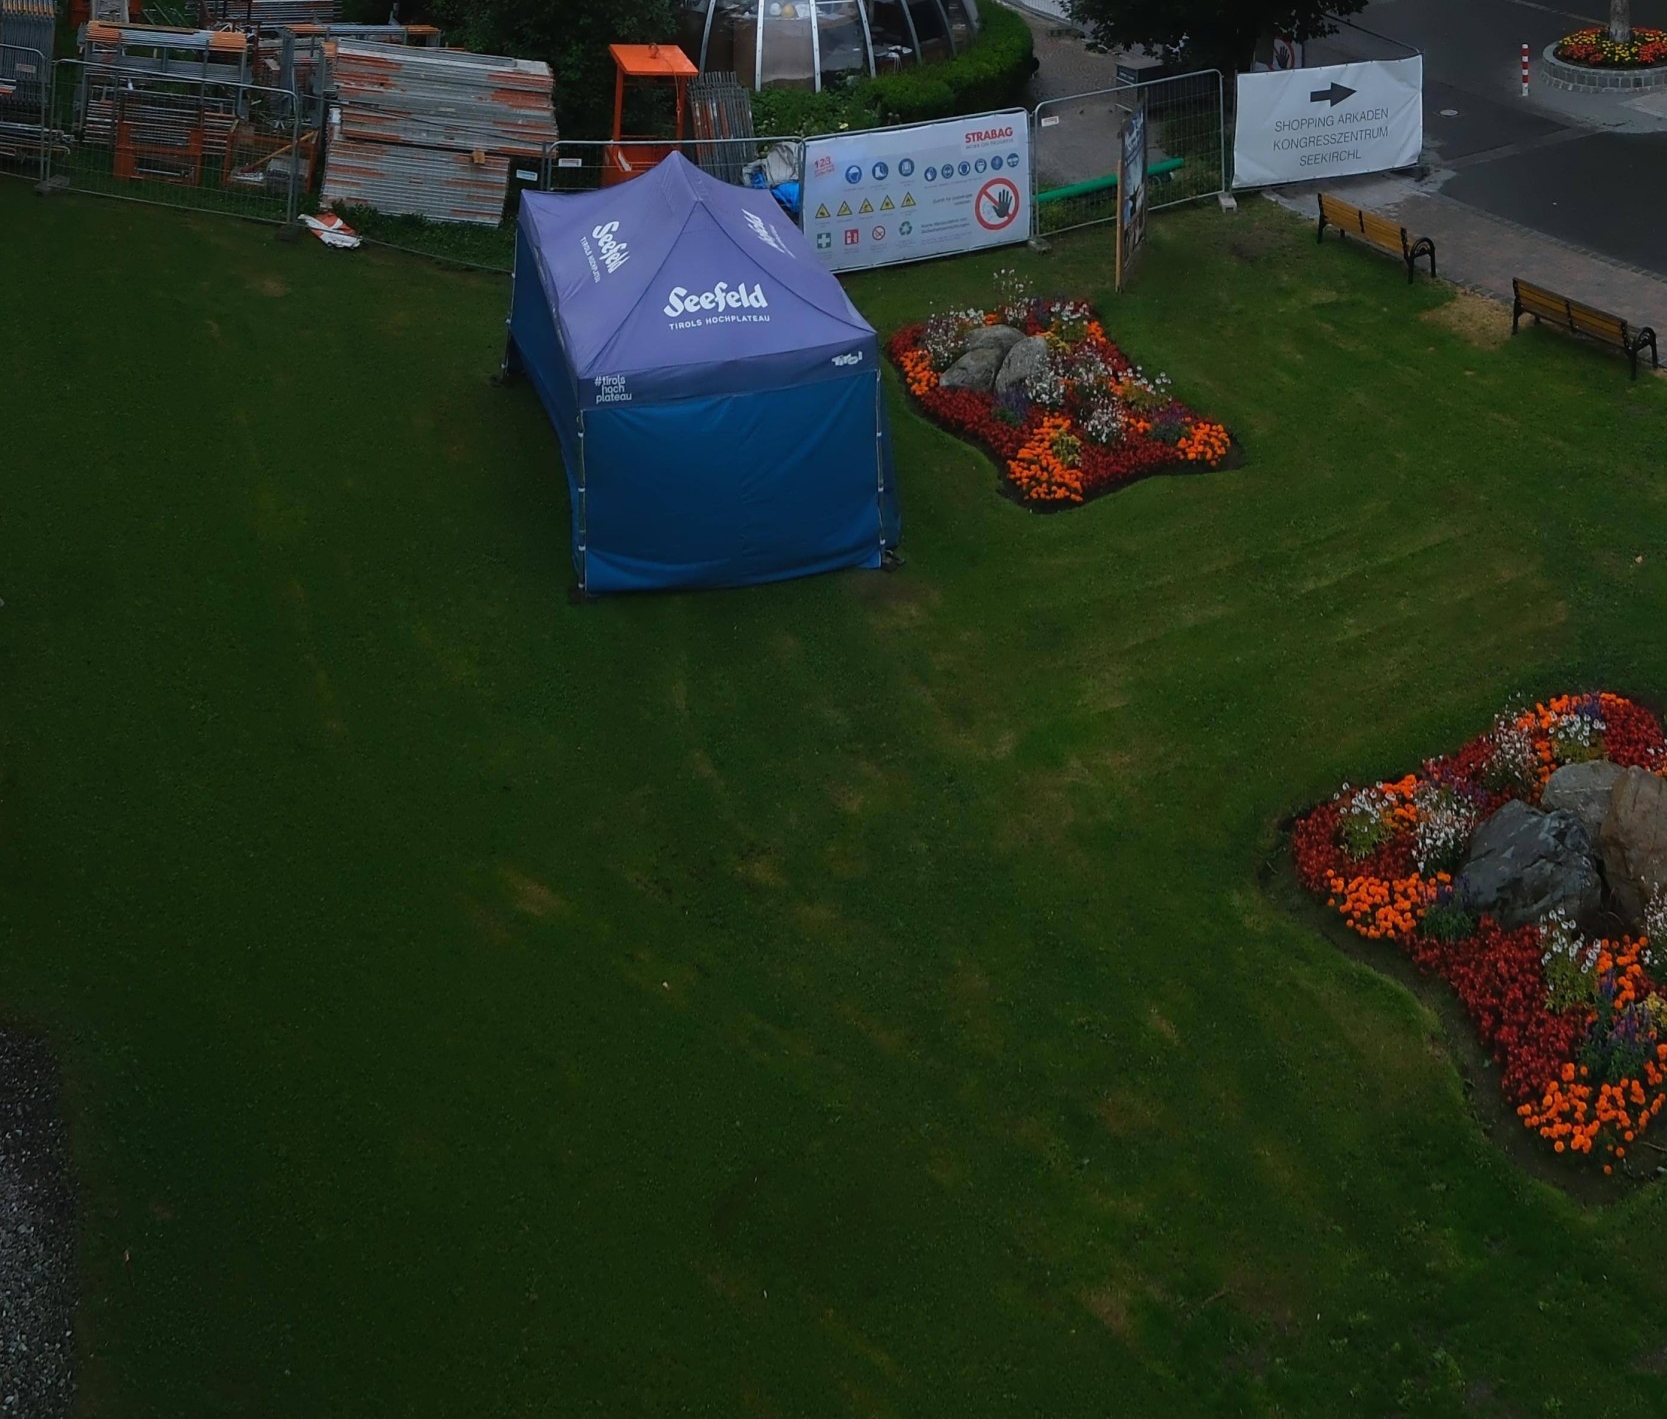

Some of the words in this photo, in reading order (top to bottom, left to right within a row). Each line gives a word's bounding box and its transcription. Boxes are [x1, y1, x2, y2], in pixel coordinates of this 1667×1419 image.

[1274, 114, 1334, 132] SHOPPING
[1337, 108, 1389, 125] ARKADEN
[965, 126, 1013, 143] STRABAG
[1273, 126, 1389, 151] KONGRESSZENTRUM
[1299, 149, 1362, 167] SEEKIRCHL
[592, 221, 631, 274] Seefeld
[663, 281, 769, 317] Seefeld
[668, 318, 703, 330] TIROLS
[705, 314, 771, 326] HOCHPLATEAU
[594, 374, 626, 387] #tirols
[601, 383, 625, 394] hoch
[595, 392, 633, 405] plateau
